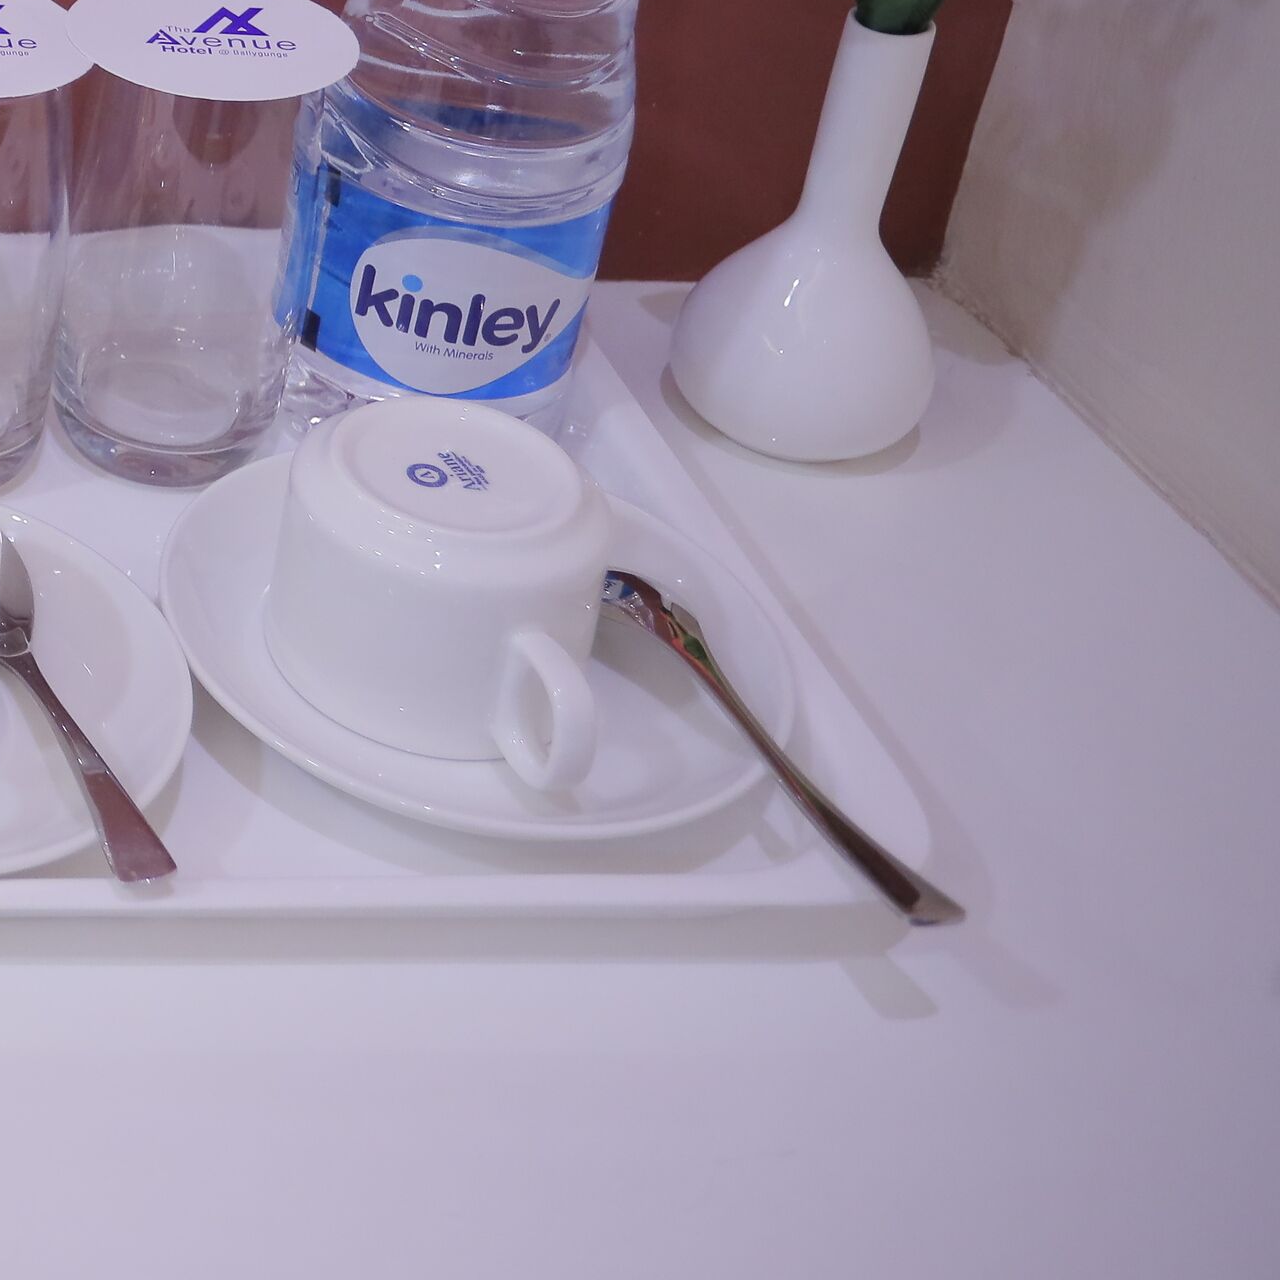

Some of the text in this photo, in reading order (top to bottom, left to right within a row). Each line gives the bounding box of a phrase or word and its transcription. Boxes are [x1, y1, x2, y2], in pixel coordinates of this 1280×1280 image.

[165, 25, 191, 33] The
[145, 29, 297, 51] Avenue
[161, 45, 213, 55] Hotel
[353, 263, 561, 355] kinley
[414, 341, 495, 362] With Minerals
